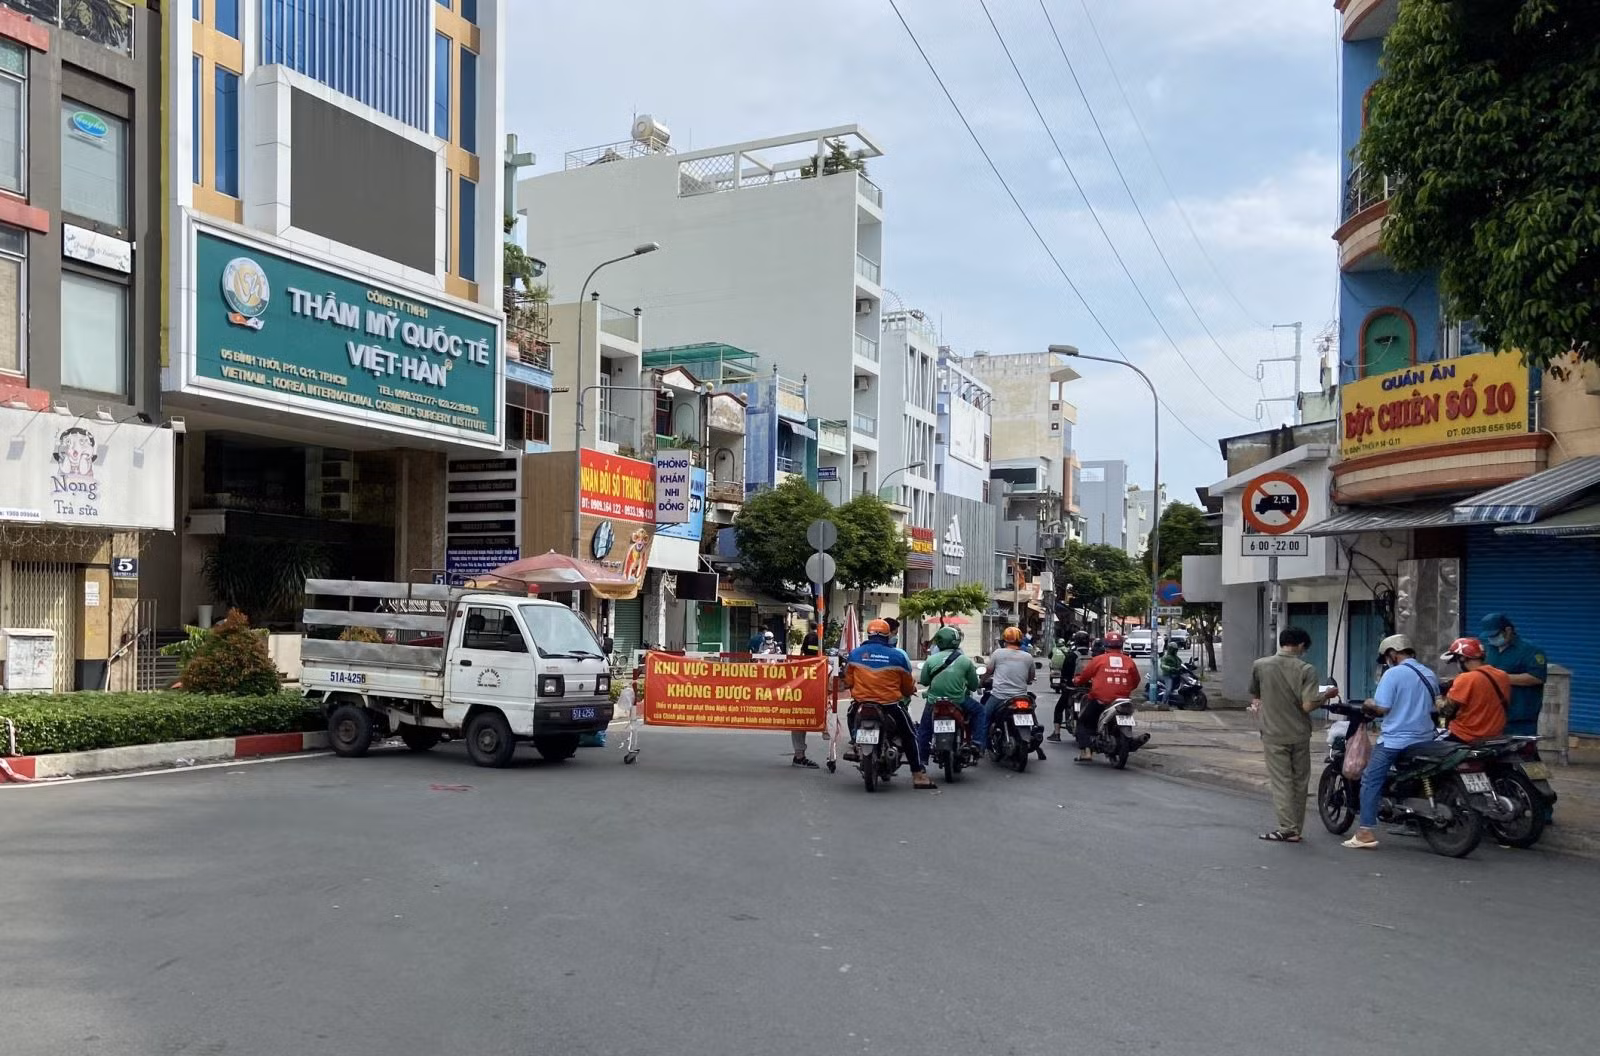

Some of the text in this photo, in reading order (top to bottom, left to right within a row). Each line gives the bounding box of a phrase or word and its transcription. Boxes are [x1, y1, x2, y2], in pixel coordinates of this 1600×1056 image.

[366, 290, 428, 318] CÔNG TY TNHH
[287, 287, 360, 330] THẨM
[366, 311, 400, 339] MỸ
[402, 322, 462, 357] QUỐC
[465, 338, 489, 365] TẾ
[1382, 364, 1456, 391] QUÁN ĂN
[221, 365, 266, 384] VIETNAM
[272, 377, 306, 393] KOREA
[307, 384, 374, 408] INTERNATIONAL
[376, 399, 416, 416] COSMETIC
[417, 407, 451, 422] SURGERY
[1345, 373, 1516, 443] BỘT CHIÊN SỐ 10
[658, 457, 688, 469] PHÒNG
[51, 475, 98, 500] Nọng
[581, 462, 599, 496] NHẬN
[600, 459, 611, 495] ĐỔI
[612, 465, 621, 497] SỐ
[622, 471, 642, 501] TRÚNG
[660, 472, 685, 483] KHÁM
[665, 489, 679, 497] NHI
[54, 499, 74, 515] Trà
[79, 504, 98, 516] sữa
[943, 543, 964, 558] adidas
[117, 558, 133, 572] 5
[654, 661, 680, 675] KHU
[683, 662, 708, 678] VỰC
[712, 663, 758, 678] PHONG
[791, 666, 799, 680] Y
[803, 664, 817, 680] TẾ
[667, 682, 802, 703] KHÔNG ĐƯỢC RA VÀO
